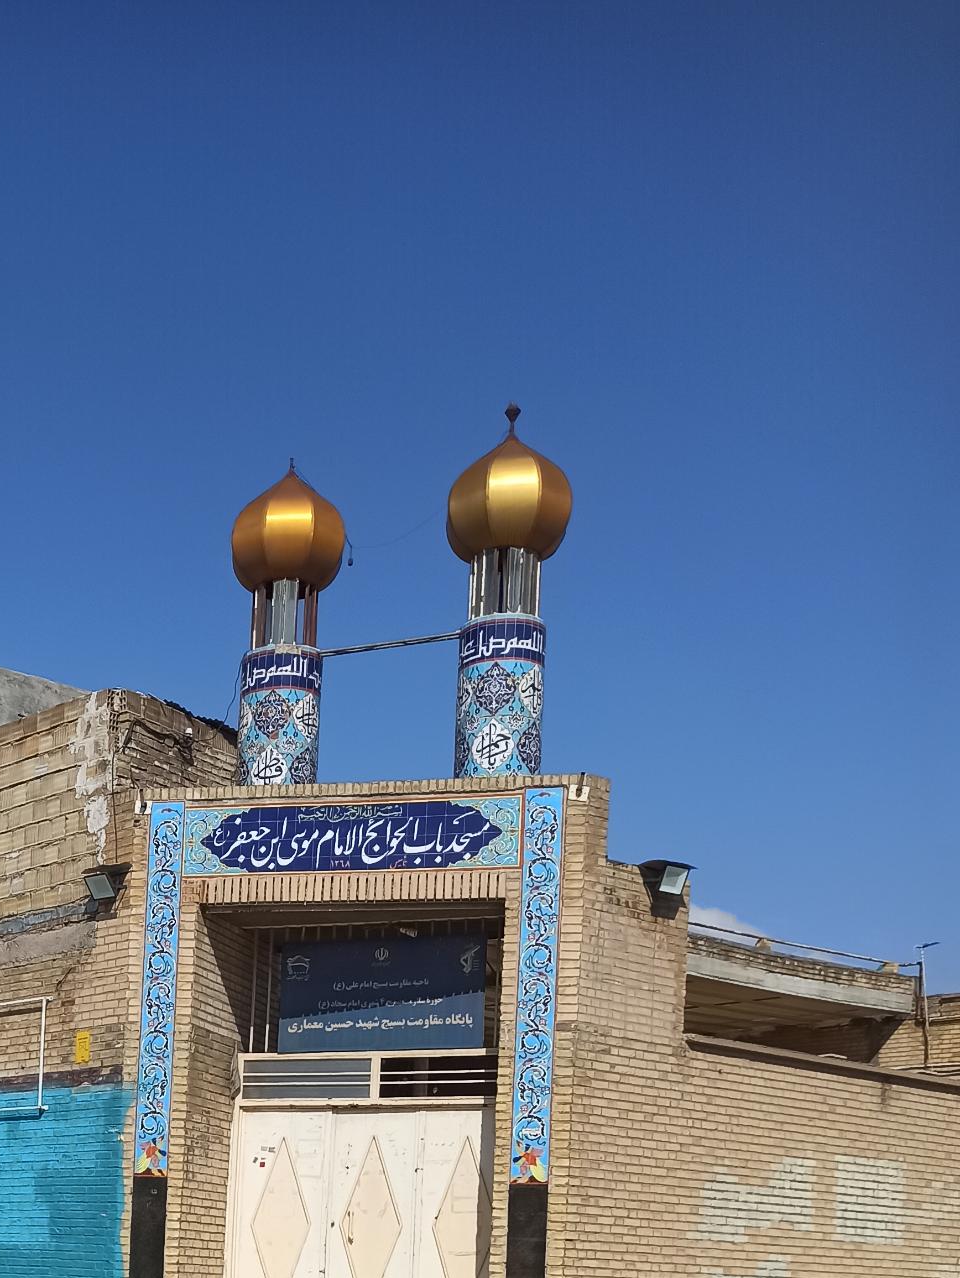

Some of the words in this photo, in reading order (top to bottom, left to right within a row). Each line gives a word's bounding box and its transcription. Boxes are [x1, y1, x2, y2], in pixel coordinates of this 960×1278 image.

[219, 817, 271, 863] جعفر
[250, 816, 288, 870] ابن
[404, 821, 443, 865] باب
[442, 811, 490, 860] مسجد
[276, 828, 319, 867] موسی
[315, 823, 364, 870] الامام
[333, 981, 345, 991] (ع)
[346, 981, 359, 991] علی
[359, 980, 372, 990] امام
[287, 1018, 324, 1033] معماری
[325, 1019, 354, 1032] حسین
[355, 1016, 380, 1030] شهید
[380, 1018, 406, 1030] بسیج
[406, 1014, 444, 1029] مقاومت
[445, 1013, 473, 1028] پایگاه
